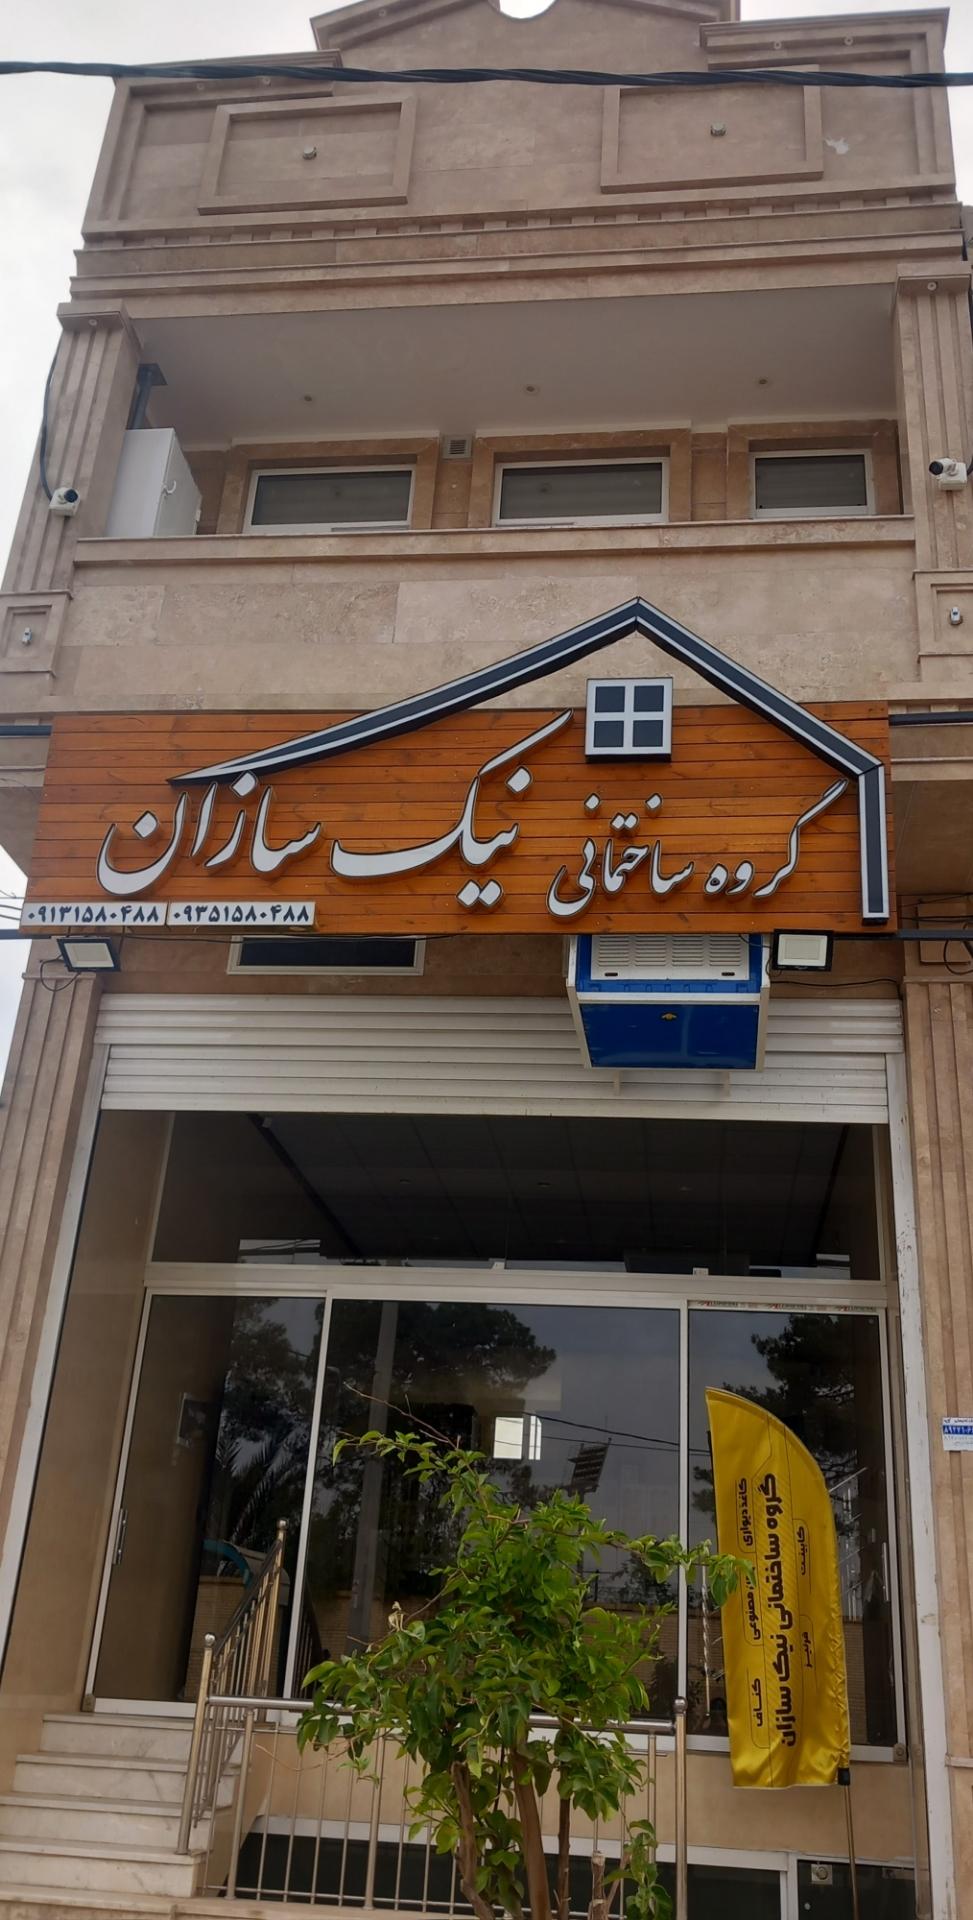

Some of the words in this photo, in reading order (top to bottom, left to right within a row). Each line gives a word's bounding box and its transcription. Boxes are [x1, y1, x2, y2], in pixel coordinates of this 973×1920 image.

[96, 770, 323, 896] سازان
[330, 707, 574, 909] نیک
[546, 791, 694, 919] ساختمانی
[703, 776, 849, 898] گروه
[28, 904, 160, 923] ۰۹۱۳۱۵۸۰۴۸۸
[173, 904, 310, 923] ۰۹۳۵۱۵۸۰۴۸۸
[739, 1509, 754, 1547] دیواری
[757, 1472, 784, 1530] گروه
[796, 1525, 809, 1576] کابینت
[763, 1533, 794, 1630] ساختمانی
[745, 1591, 761, 1641] مصنوعی
[769, 1633, 794, 1683] نیک
[751, 1677, 763, 1728] کناف
[775, 1685, 798, 1747] سازان
